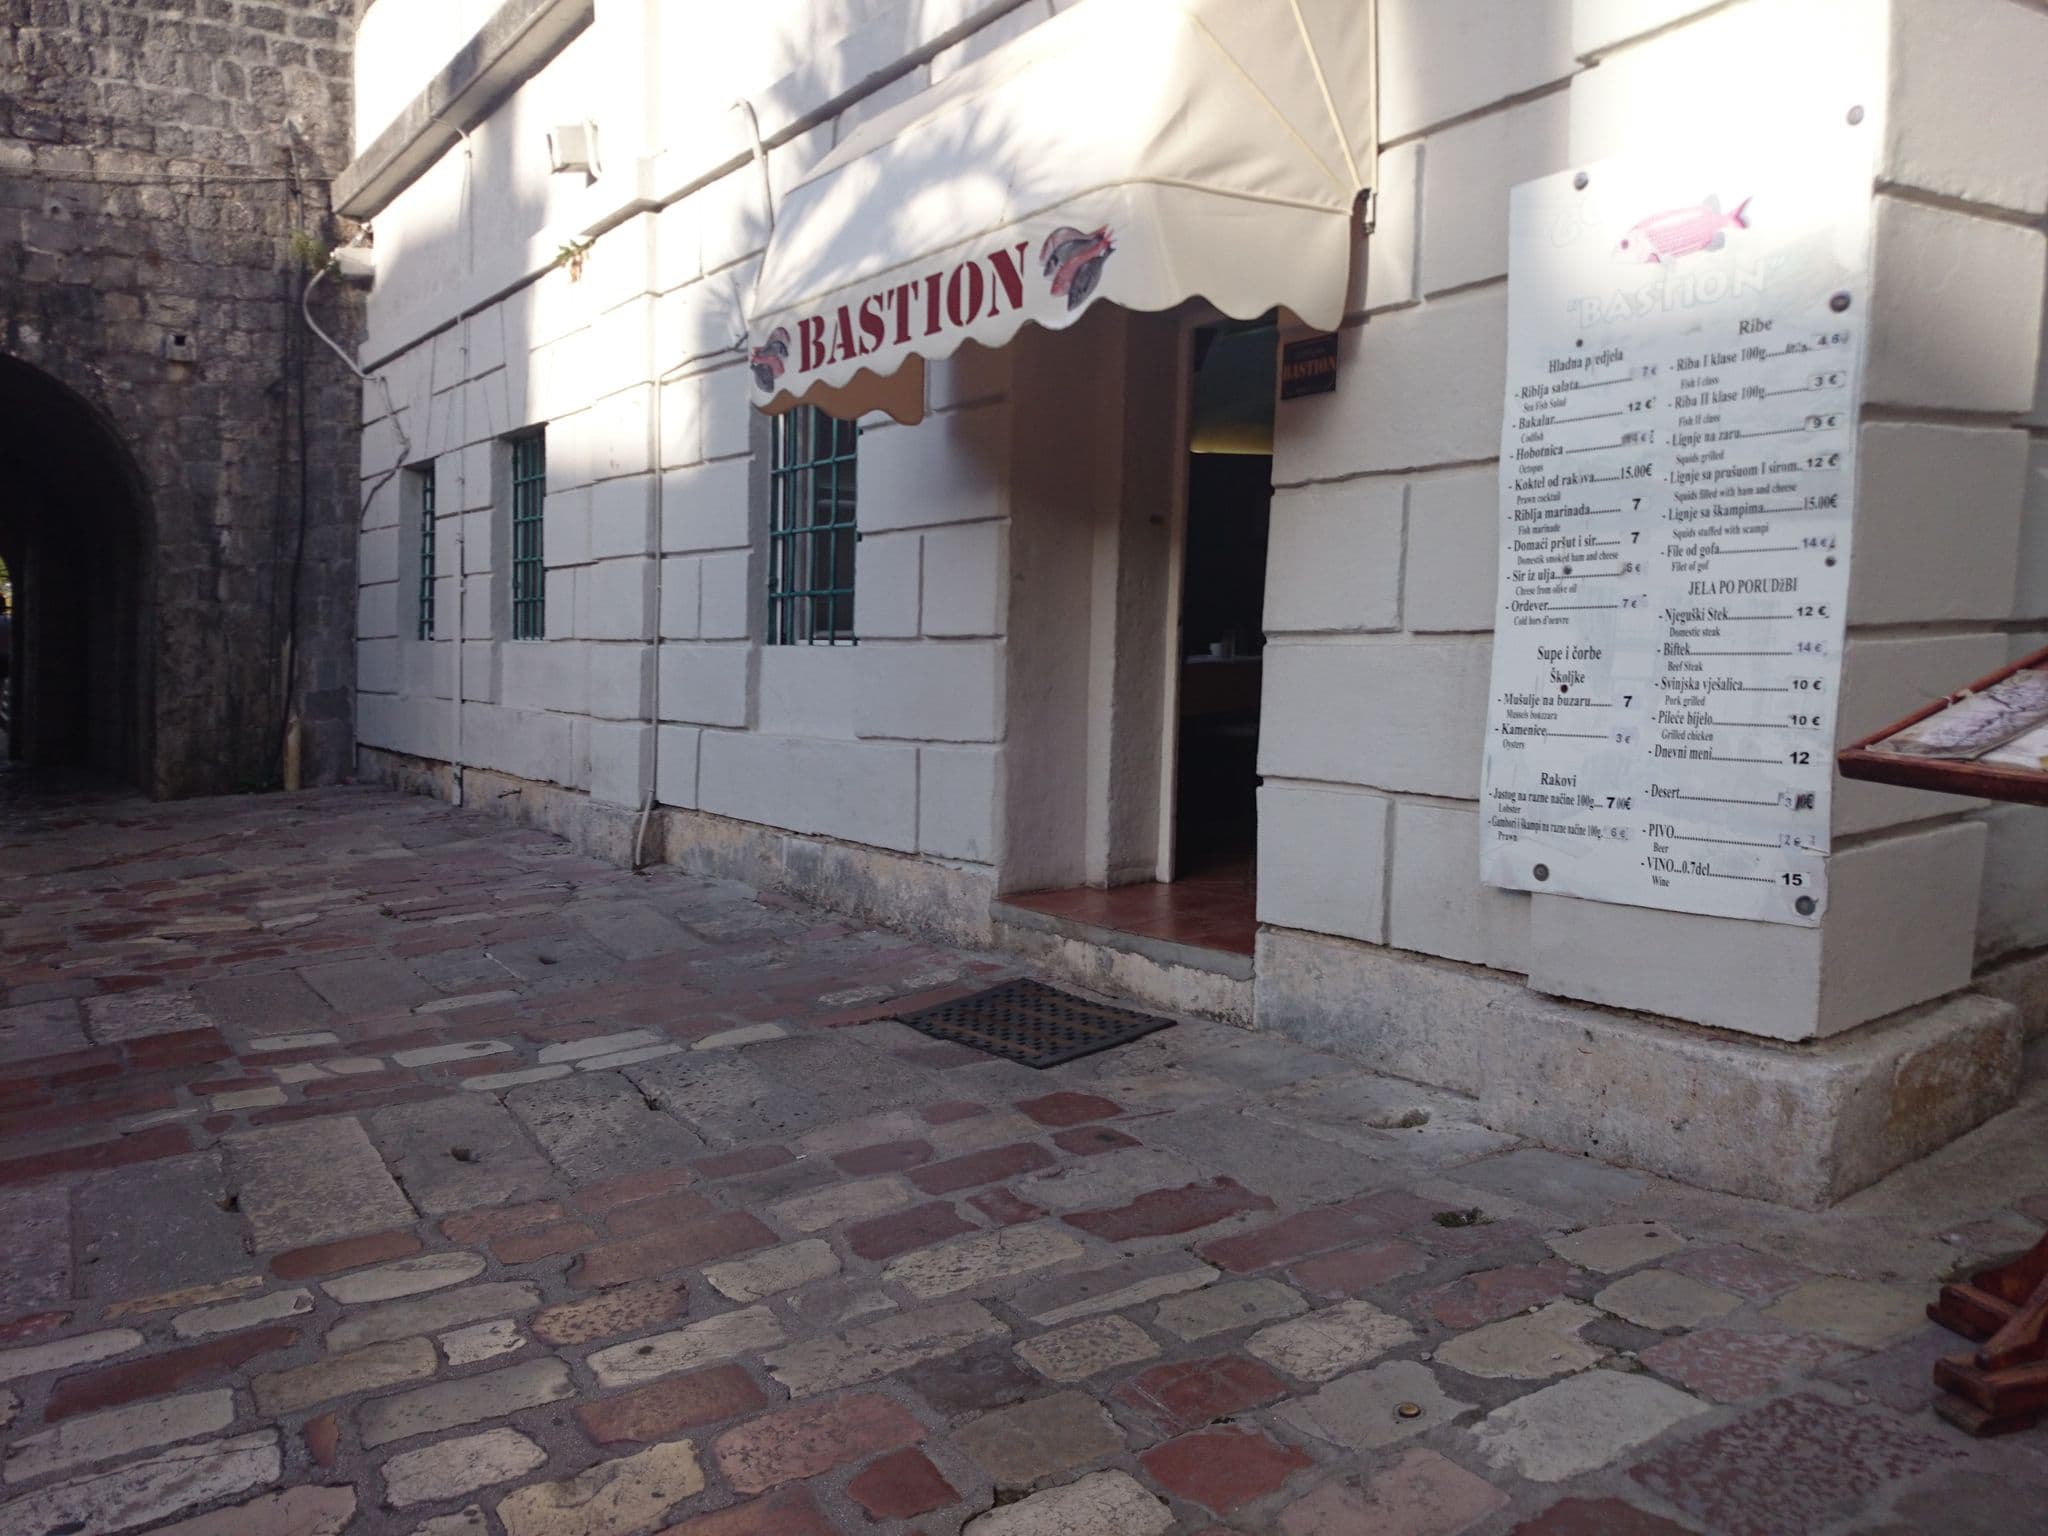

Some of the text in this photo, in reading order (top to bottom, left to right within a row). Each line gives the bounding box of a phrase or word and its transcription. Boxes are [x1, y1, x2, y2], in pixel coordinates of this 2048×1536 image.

[797, 241, 1029, 374] BASTION
[1739, 318, 1773, 335] Ribe
[1549, 348, 1624, 374] Hladna pedjela
[1676, 346, 1767, 372] Riba klase 100g
[1281, 356, 1337, 380] BASTION
[1521, 384, 1549, 399] Riblja
[1674, 394, 1697, 409] Riba
[1712, 390, 1738, 404] klase
[1741, 385, 1766, 399] 100g
[1814, 376, 1823, 387] 3
[1828, 374, 1837, 385] €
[1519, 400, 1652, 430] Bakalar 12 €
[1672, 433, 1702, 448] Lignje
[1704, 432, 1716, 442] na
[1516, 444, 1563, 460] Hobotnica
[1670, 453, 1839, 485] Lignje sa sirom 12 €
[1515, 475, 1545, 491] Koktel
[1547, 474, 1559, 487] od
[1620, 463, 1652, 480] 15.00€
[1720, 488, 1735, 497] with
[1737, 486, 1754, 496] ham
[1756, 484, 1771, 494] and
[1772, 483, 1797, 493] cheese
[1514, 498, 1641, 523] Riblja marinada 7
[1668, 494, 1838, 522] Lignje sa škampima 15.00€
[1518, 526, 1531, 535] Fish
[1698, 526, 1722, 537] stuffed
[1724, 525, 1741, 535] with
[1742, 523, 1769, 535] scampi
[1584, 535, 1596, 546] sir
[1631, 532, 1640, 544] 7
[1667, 538, 1817, 557] File od gofa 14
[1586, 552, 1598, 562] and
[1599, 551, 1619, 561] cheese
[1672, 562, 1688, 571] Filet
[1512, 568, 1555, 584] Sir iz ulja
[1688, 581, 1715, 596] JELA
[1719, 581, 1734, 593] PO
[1511, 600, 1549, 612] Ordever
[1665, 606, 1827, 625] Njeguški Stek 12 €
[1702, 627, 1720, 636] steak
[1537, 646, 1602, 663] Supe čorbe
[1663, 642, 1823, 656] Biftek 14 €
[1668, 661, 1703, 671] Beef Steak
[1550, 668, 1585, 686] Školjke
[1661, 677, 1822, 694] Svinjska vješalica 10 €
[1543, 697, 1554, 706] na
[1557, 694, 1591, 707] buzaru
[1623, 696, 1632, 707] 7
[1665, 696, 1706, 708] Pork grilled
[1658, 711, 1821, 728] Pileće bijelo 10 €
[1502, 723, 1546, 737] Kamenice
[1661, 730, 1714, 742] Grilled chicken
[1654, 744, 1810, 765] Dnevni meni 12
[1541, 772, 1576, 787] Rakovi
[1651, 784, 1680, 799] Desert
[1518, 793, 1527, 802] na
[1528, 793, 1549, 803] razne
[1606, 797, 1615, 808] 7
[1498, 803, 1521, 814] Lobster
[1648, 824, 1675, 838] PIVO
[1653, 842, 1669, 853] Beer
[1652, 876, 1670, 887] Wine
[1782, 873, 1802, 886] 15
